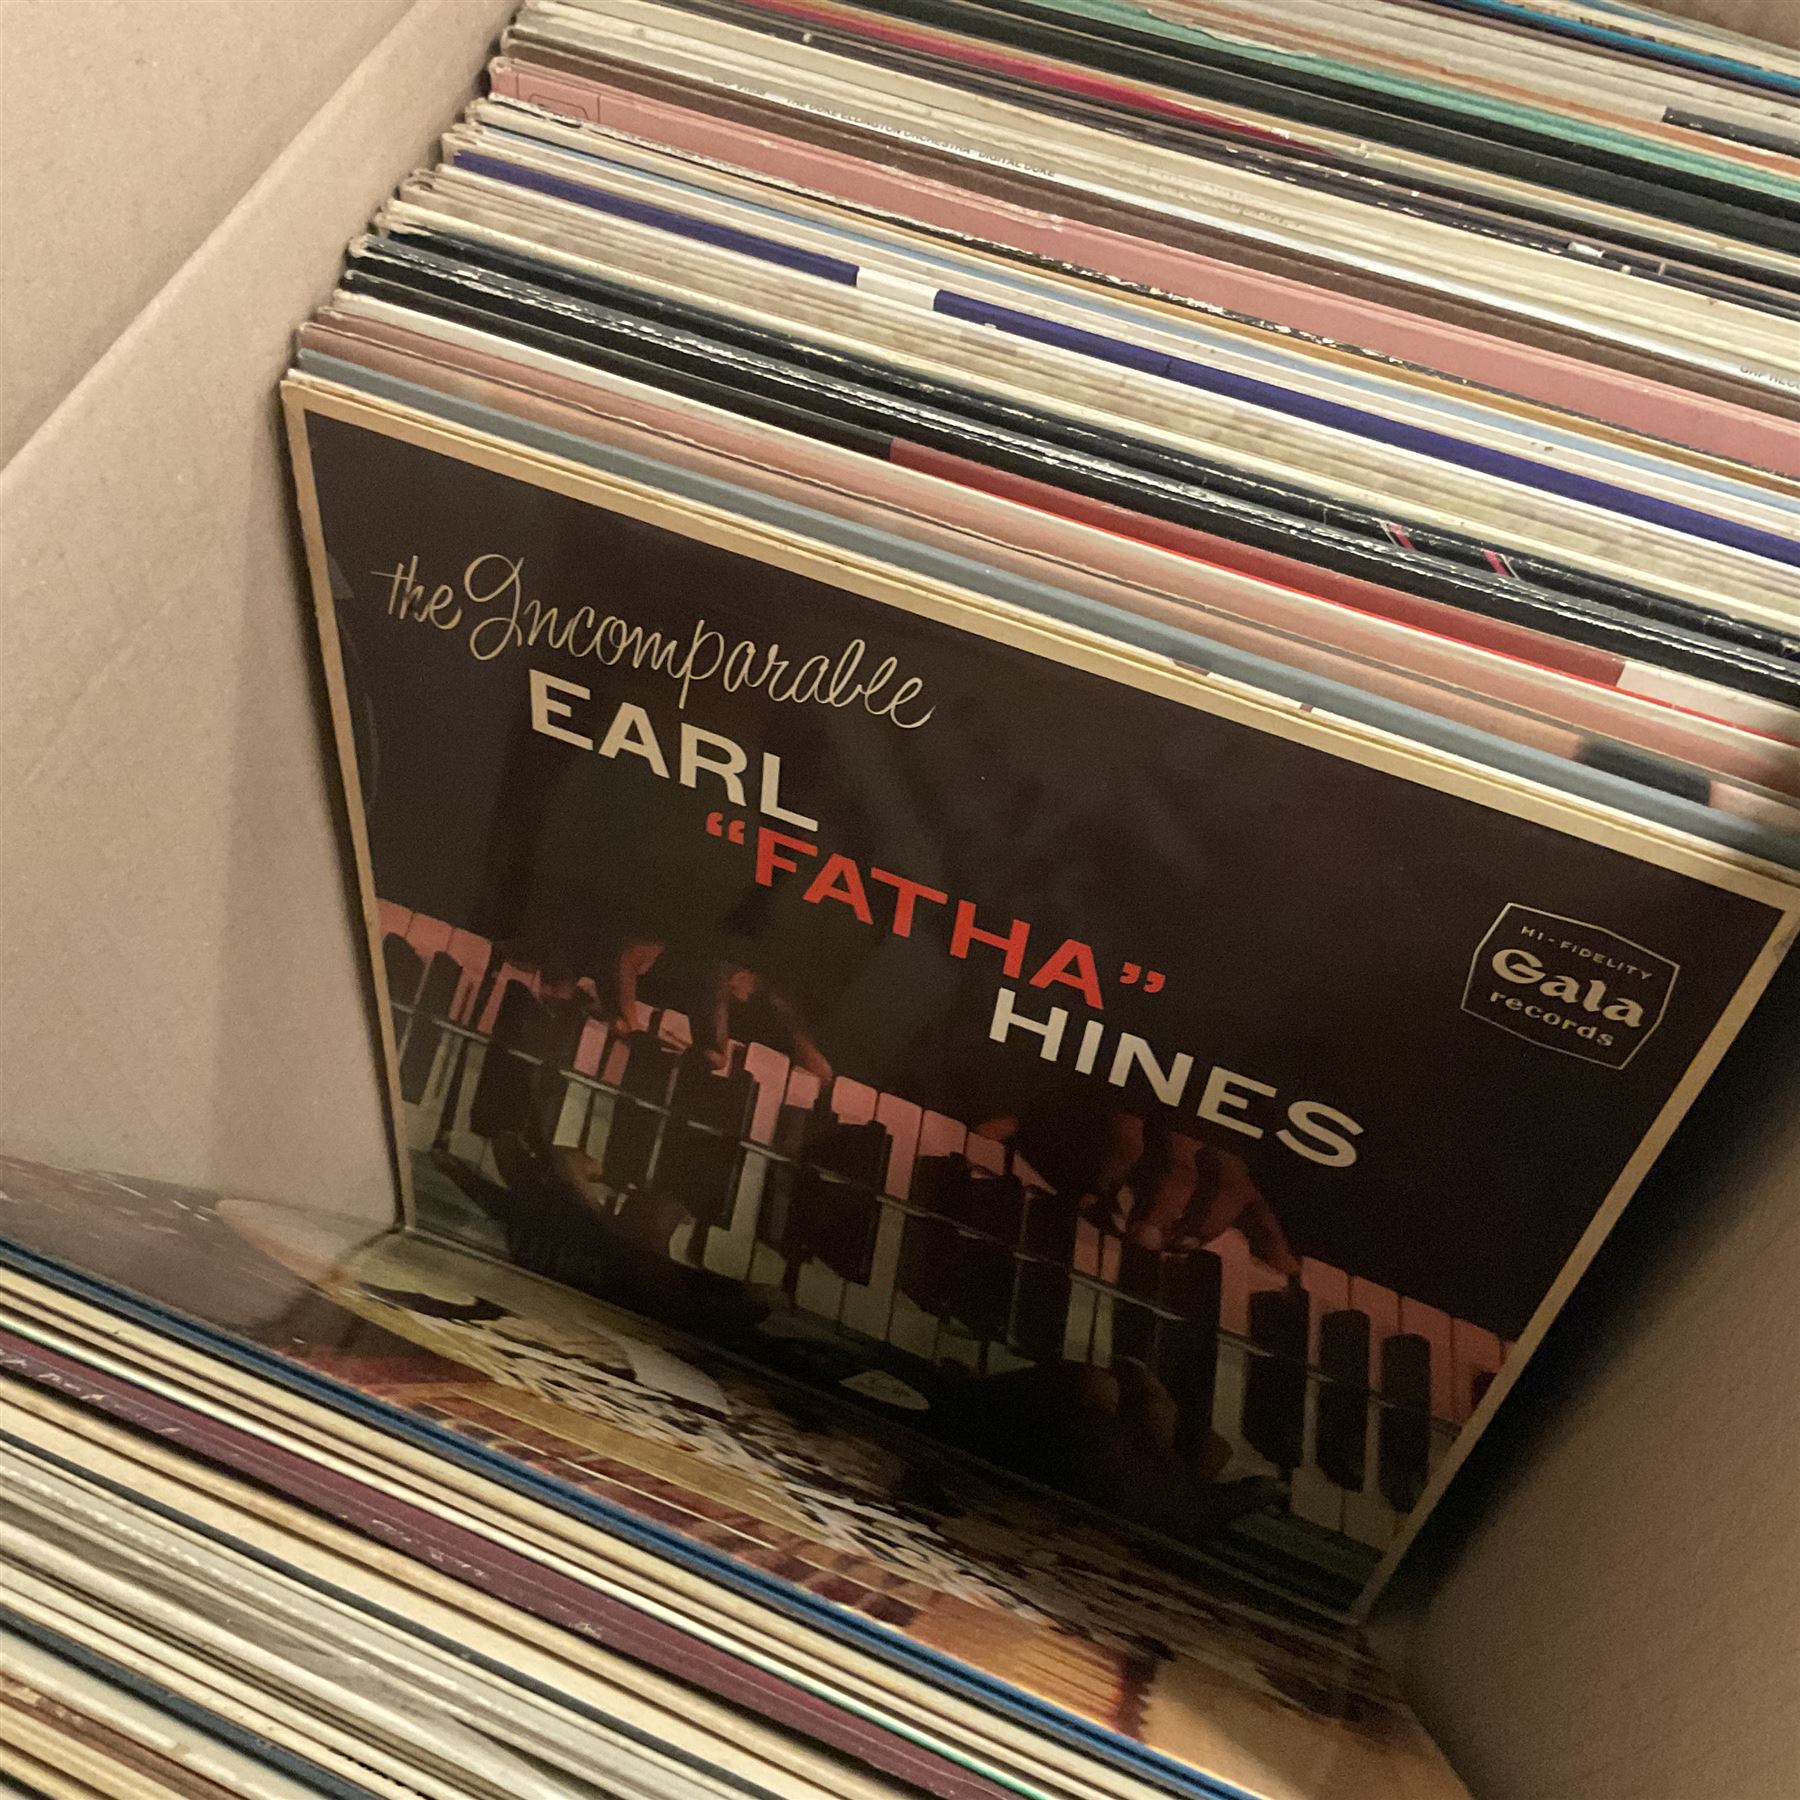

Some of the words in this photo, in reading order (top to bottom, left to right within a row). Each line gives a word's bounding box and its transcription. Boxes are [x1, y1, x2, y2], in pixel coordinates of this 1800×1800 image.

[371, 555, 462, 629] the
[463, 553, 937, 729] Incomparable
[528, 668, 819, 832] EARL
[1489, 991, 1615, 1047] records
[1491, 948, 1644, 1028] Gala
[988, 987, 1365, 1168] HINES
